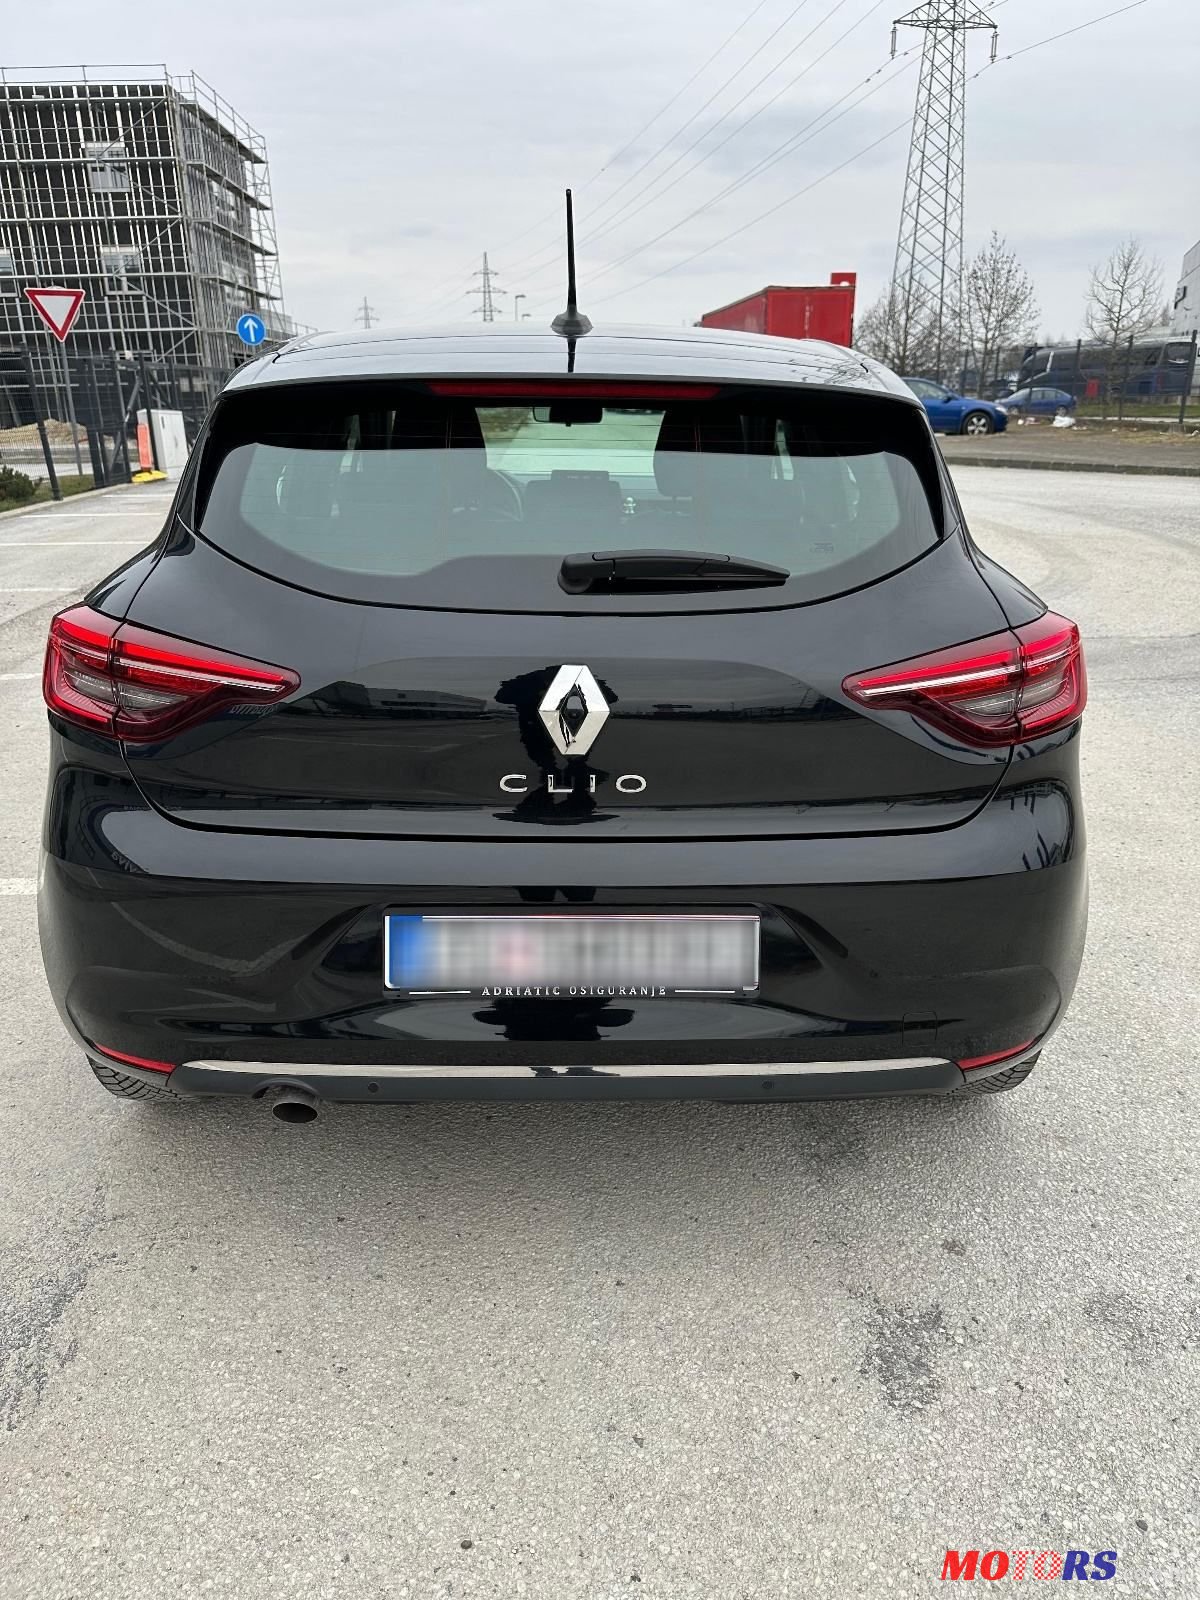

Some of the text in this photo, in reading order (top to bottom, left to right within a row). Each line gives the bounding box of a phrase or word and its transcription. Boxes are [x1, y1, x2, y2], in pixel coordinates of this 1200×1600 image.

[499, 774, 647, 793] CLIO
[481, 985, 667, 997] ADRIATIC OSIGURANJE
